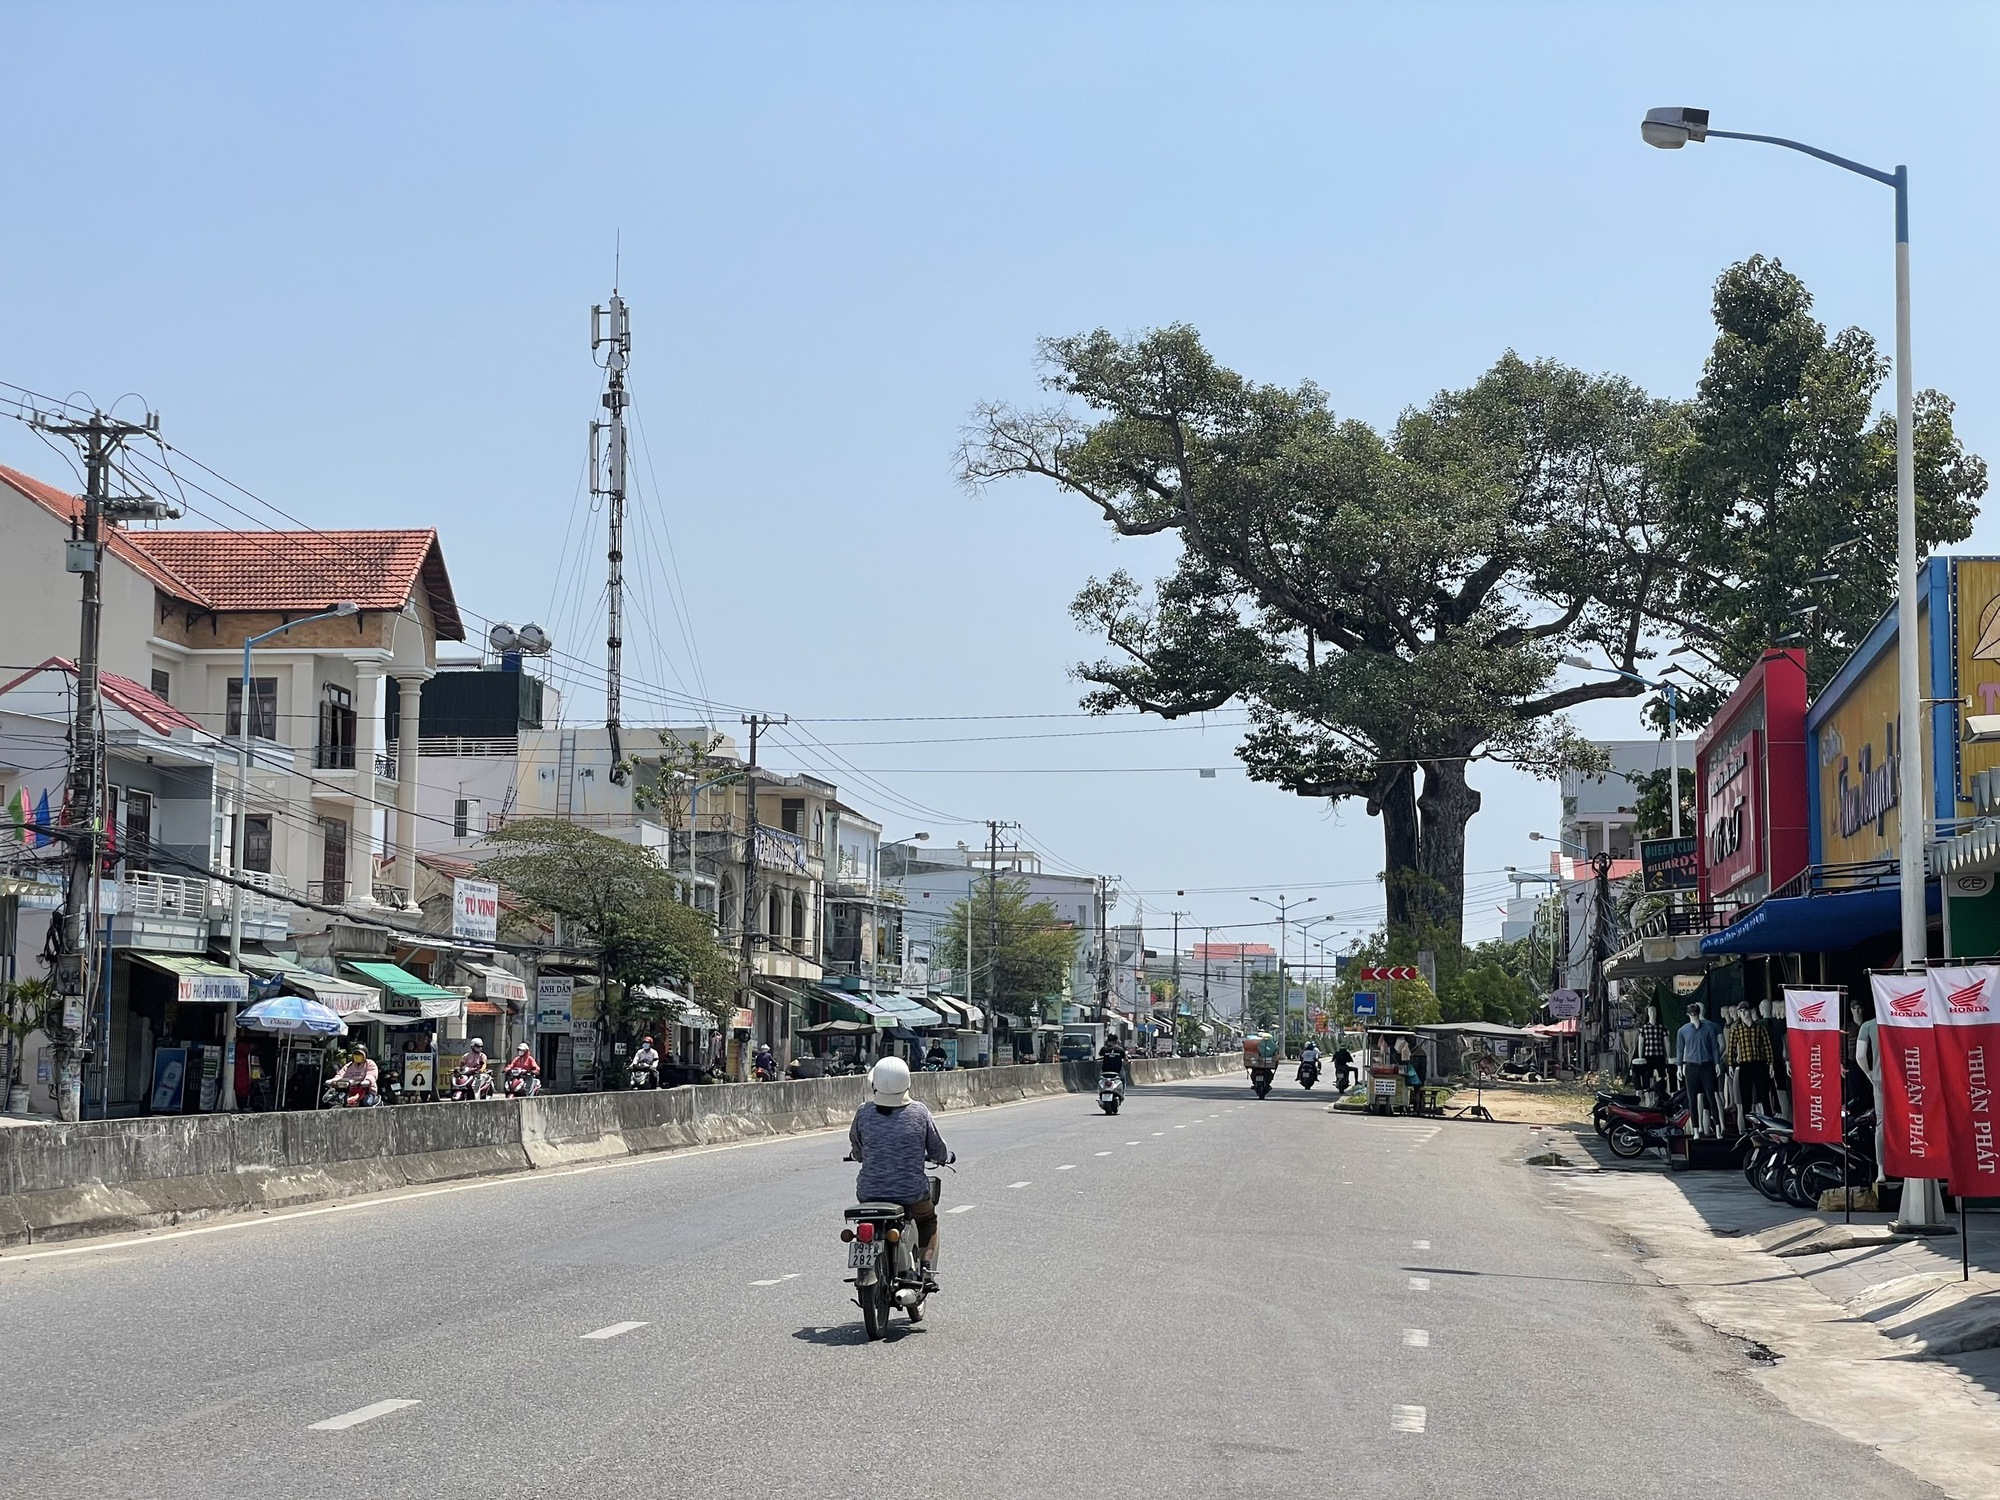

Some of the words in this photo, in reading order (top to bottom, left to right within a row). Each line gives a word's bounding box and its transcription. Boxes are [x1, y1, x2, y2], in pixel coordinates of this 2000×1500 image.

[1645, 843, 1674, 858] QUEEN
[539, 985, 556, 994] ANH
[1890, 1010, 1928, 1018] HONDA
[1949, 1005, 1990, 1014] HONDA
[1808, 1044, 1825, 1090] THUẬN
[1904, 1046, 1926, 1106] THUẬN
[1967, 1045, 1992, 1113] THUẬN
[1810, 1095, 1826, 1131] PHÁT
[1908, 1112, 1929, 1158] PHÁT
[1974, 1120, 1999, 1174] PHÁT
[853, 1254, 877, 1266] 282
